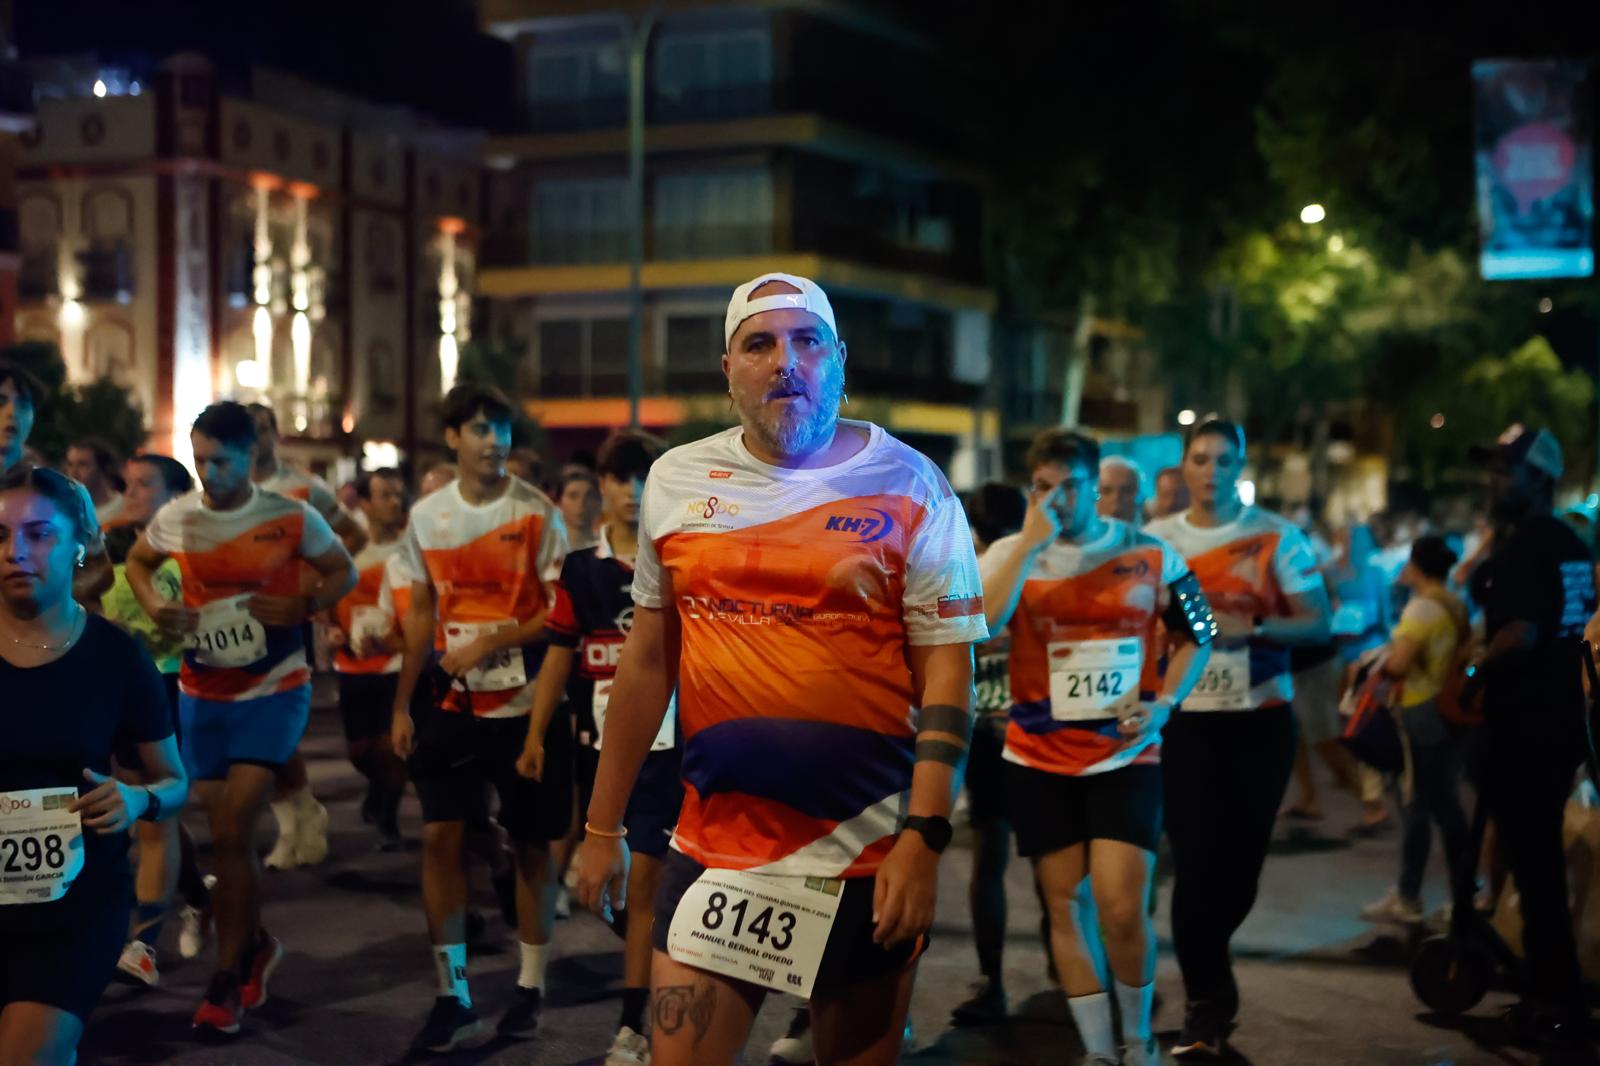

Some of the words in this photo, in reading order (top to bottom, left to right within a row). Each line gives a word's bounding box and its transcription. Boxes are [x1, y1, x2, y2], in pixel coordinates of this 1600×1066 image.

[709, 597, 814, 619] NOCTURNA
[1067, 671, 1123, 698] 2142
[0, 834, 65, 873] 298
[702, 891, 796, 951] 8143
[691, 930, 726, 946] MANUEL
[727, 940, 760, 957] BERNAL
[761, 952, 794, 967] OVIEDO
